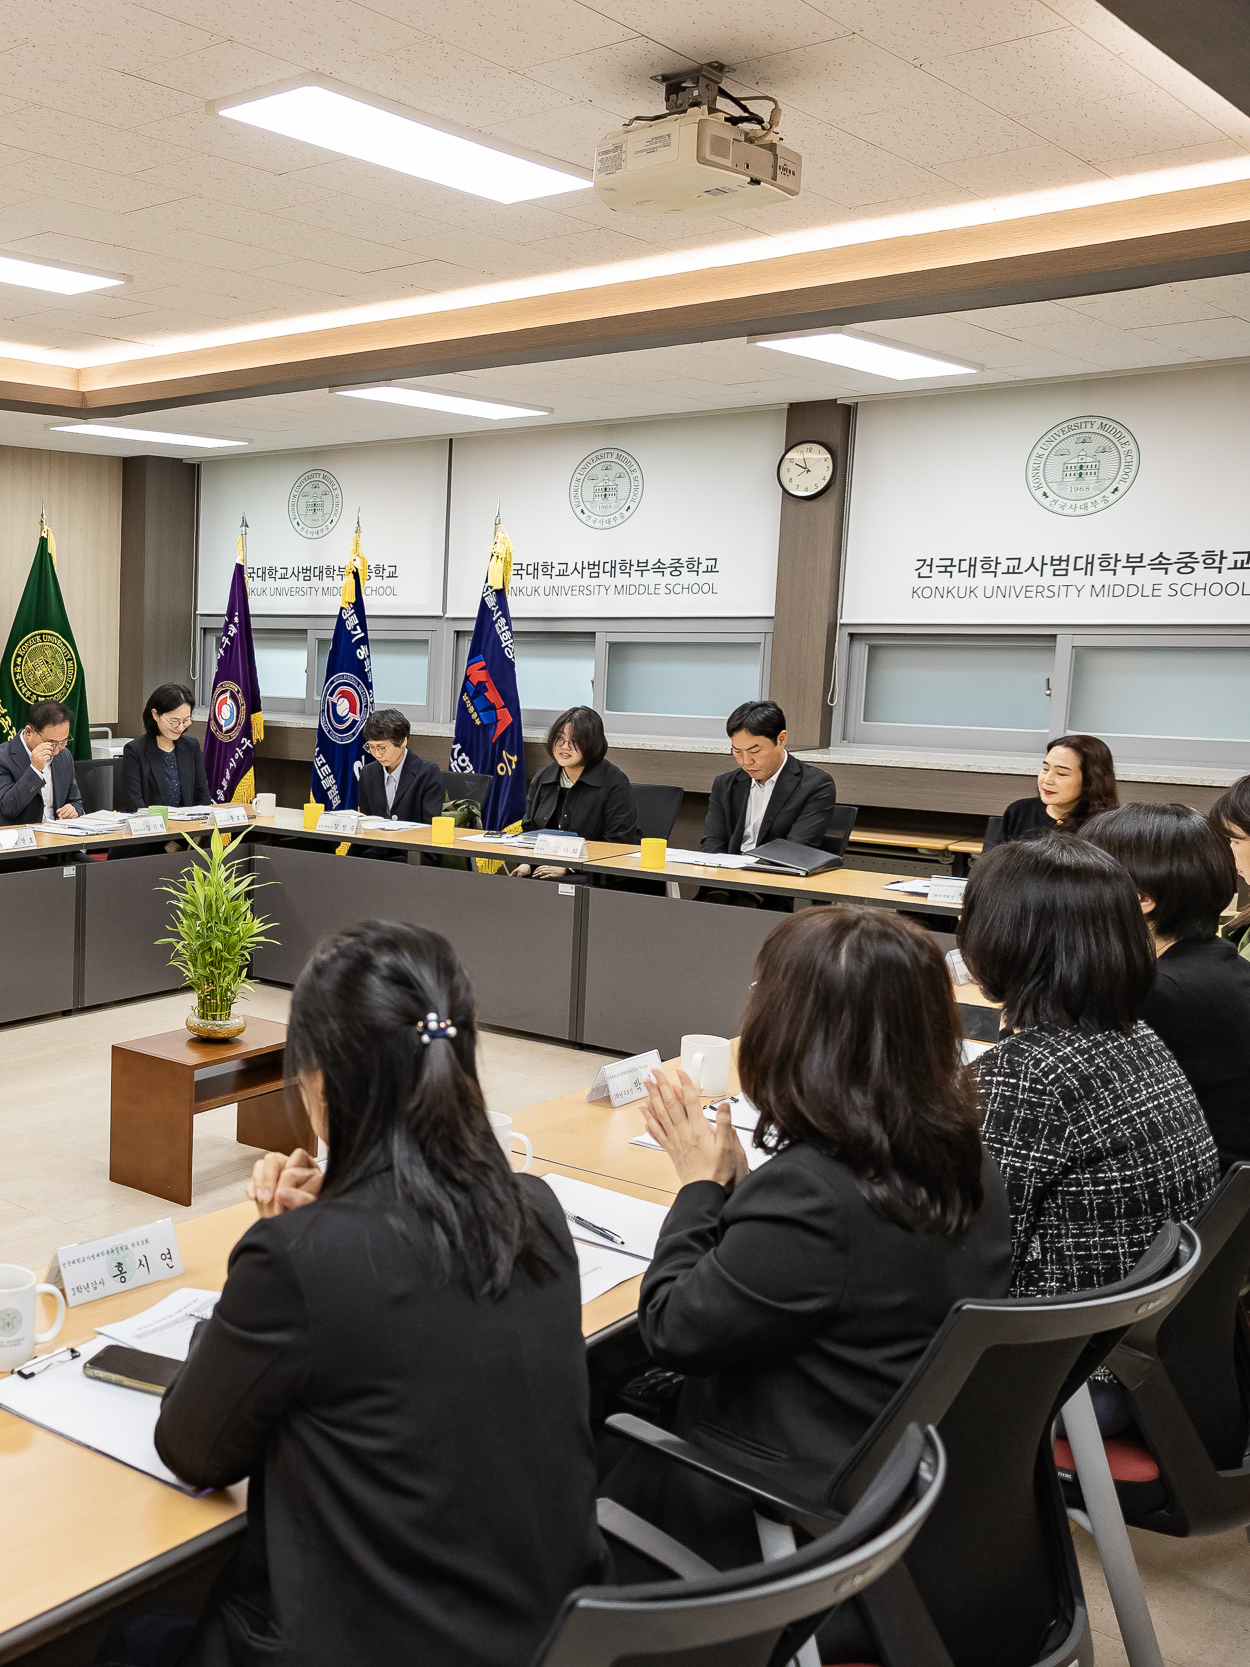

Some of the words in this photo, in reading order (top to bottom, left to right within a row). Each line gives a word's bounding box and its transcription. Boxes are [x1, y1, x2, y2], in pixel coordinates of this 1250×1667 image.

[1031, 452, 1045, 491] KONKUK
[1040, 420, 1096, 451] UNIVERSITY
[1097, 422, 1131, 449] MIDDLE
[1117, 449, 1134, 485] SCHOOL
[573, 477, 582, 509] KONKUK
[579, 452, 615, 475] UNIVERSITY
[615, 453, 638, 475] MIDDLE
[629, 475, 640, 504] SCHOOL
[1049, 494, 1110, 513] 건국사대부중
[512, 556, 719, 580] 국대학교사범대학부속중학교
[914, 549, 1250, 580] 건국대학교사범대학부속중학교
[269, 587, 319, 597] UNIVERSITY
[322, 586, 343, 597] MIDD
[363, 585, 398, 597] CHOOL
[508, 585, 541, 597] NKUK
[543, 584, 611, 597] UNIVERSITY
[614, 583, 661, 596] MIDDLE
[664, 582, 718, 595] SCHOOL
[911, 585, 979, 599] KONKUK
[983, 584, 1085, 599] UNIVERSITY
[1090, 583, 1162, 598] MIDDLE
[1167, 581, 1250, 597] SCHOOL
[17, 634, 42, 656] KONKUK
[42, 634, 72, 660] UNIVERSITY
